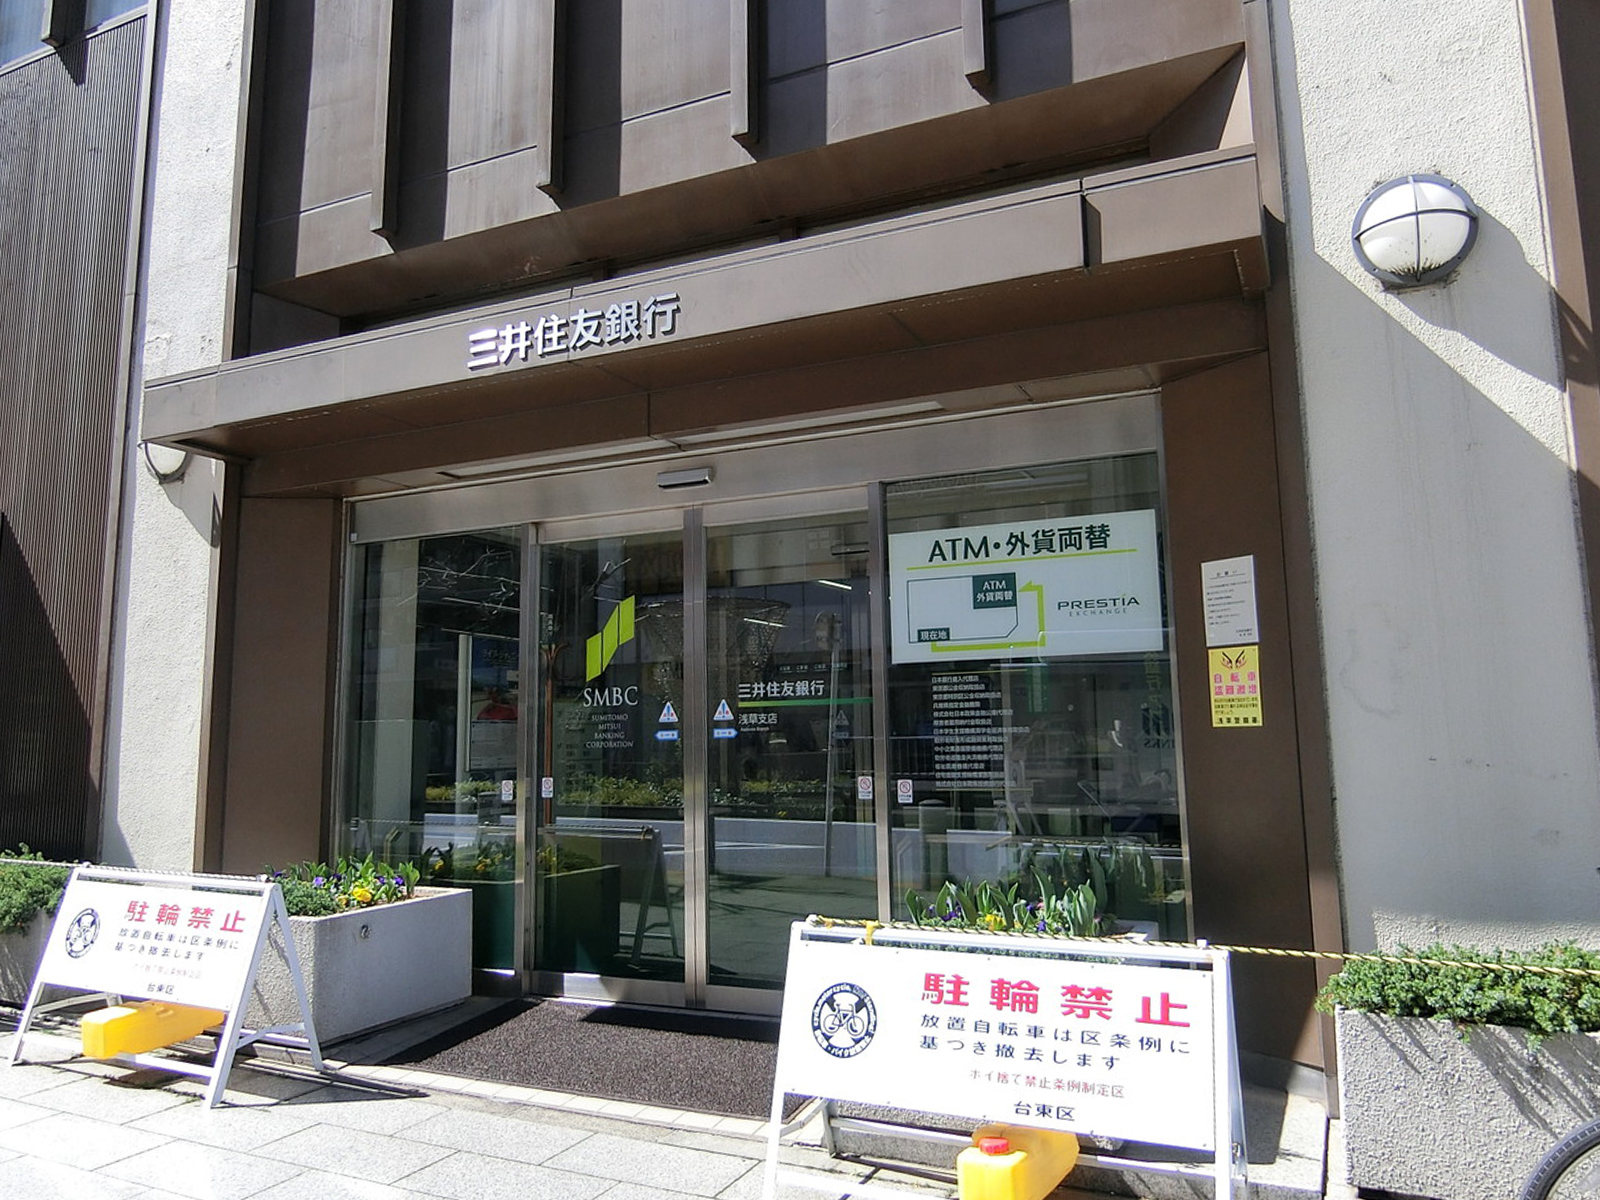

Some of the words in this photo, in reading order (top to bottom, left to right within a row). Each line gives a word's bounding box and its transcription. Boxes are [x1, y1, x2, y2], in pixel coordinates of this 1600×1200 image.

[467, 292, 680, 369] 三井住友銀行
[983, 580, 1007, 590] ATM
[976, 590, 1014, 602] 外貨両替
[1069, 608, 1127, 618] EXCHANGE
[920, 629, 949, 641] 現在地
[583, 686, 638, 707] SMBC
[738, 680, 825, 698] 三井住友銀行
[592, 713, 629, 721] SUMITOMO
[738, 713, 778, 725] 浅草支店
[585, 740, 634, 748] CORPORATION
[127, 900, 246, 933] 駐輪禁止
[147, 982, 175, 995] 台東区
[921, 973, 1191, 1028] 駐輪禁止
[921, 1013, 1191, 1054] 放置自転車は区条例に
[919, 1035, 1120, 1070] 基つき撤去します
[1014, 1101, 1075, 1121] 台東区
